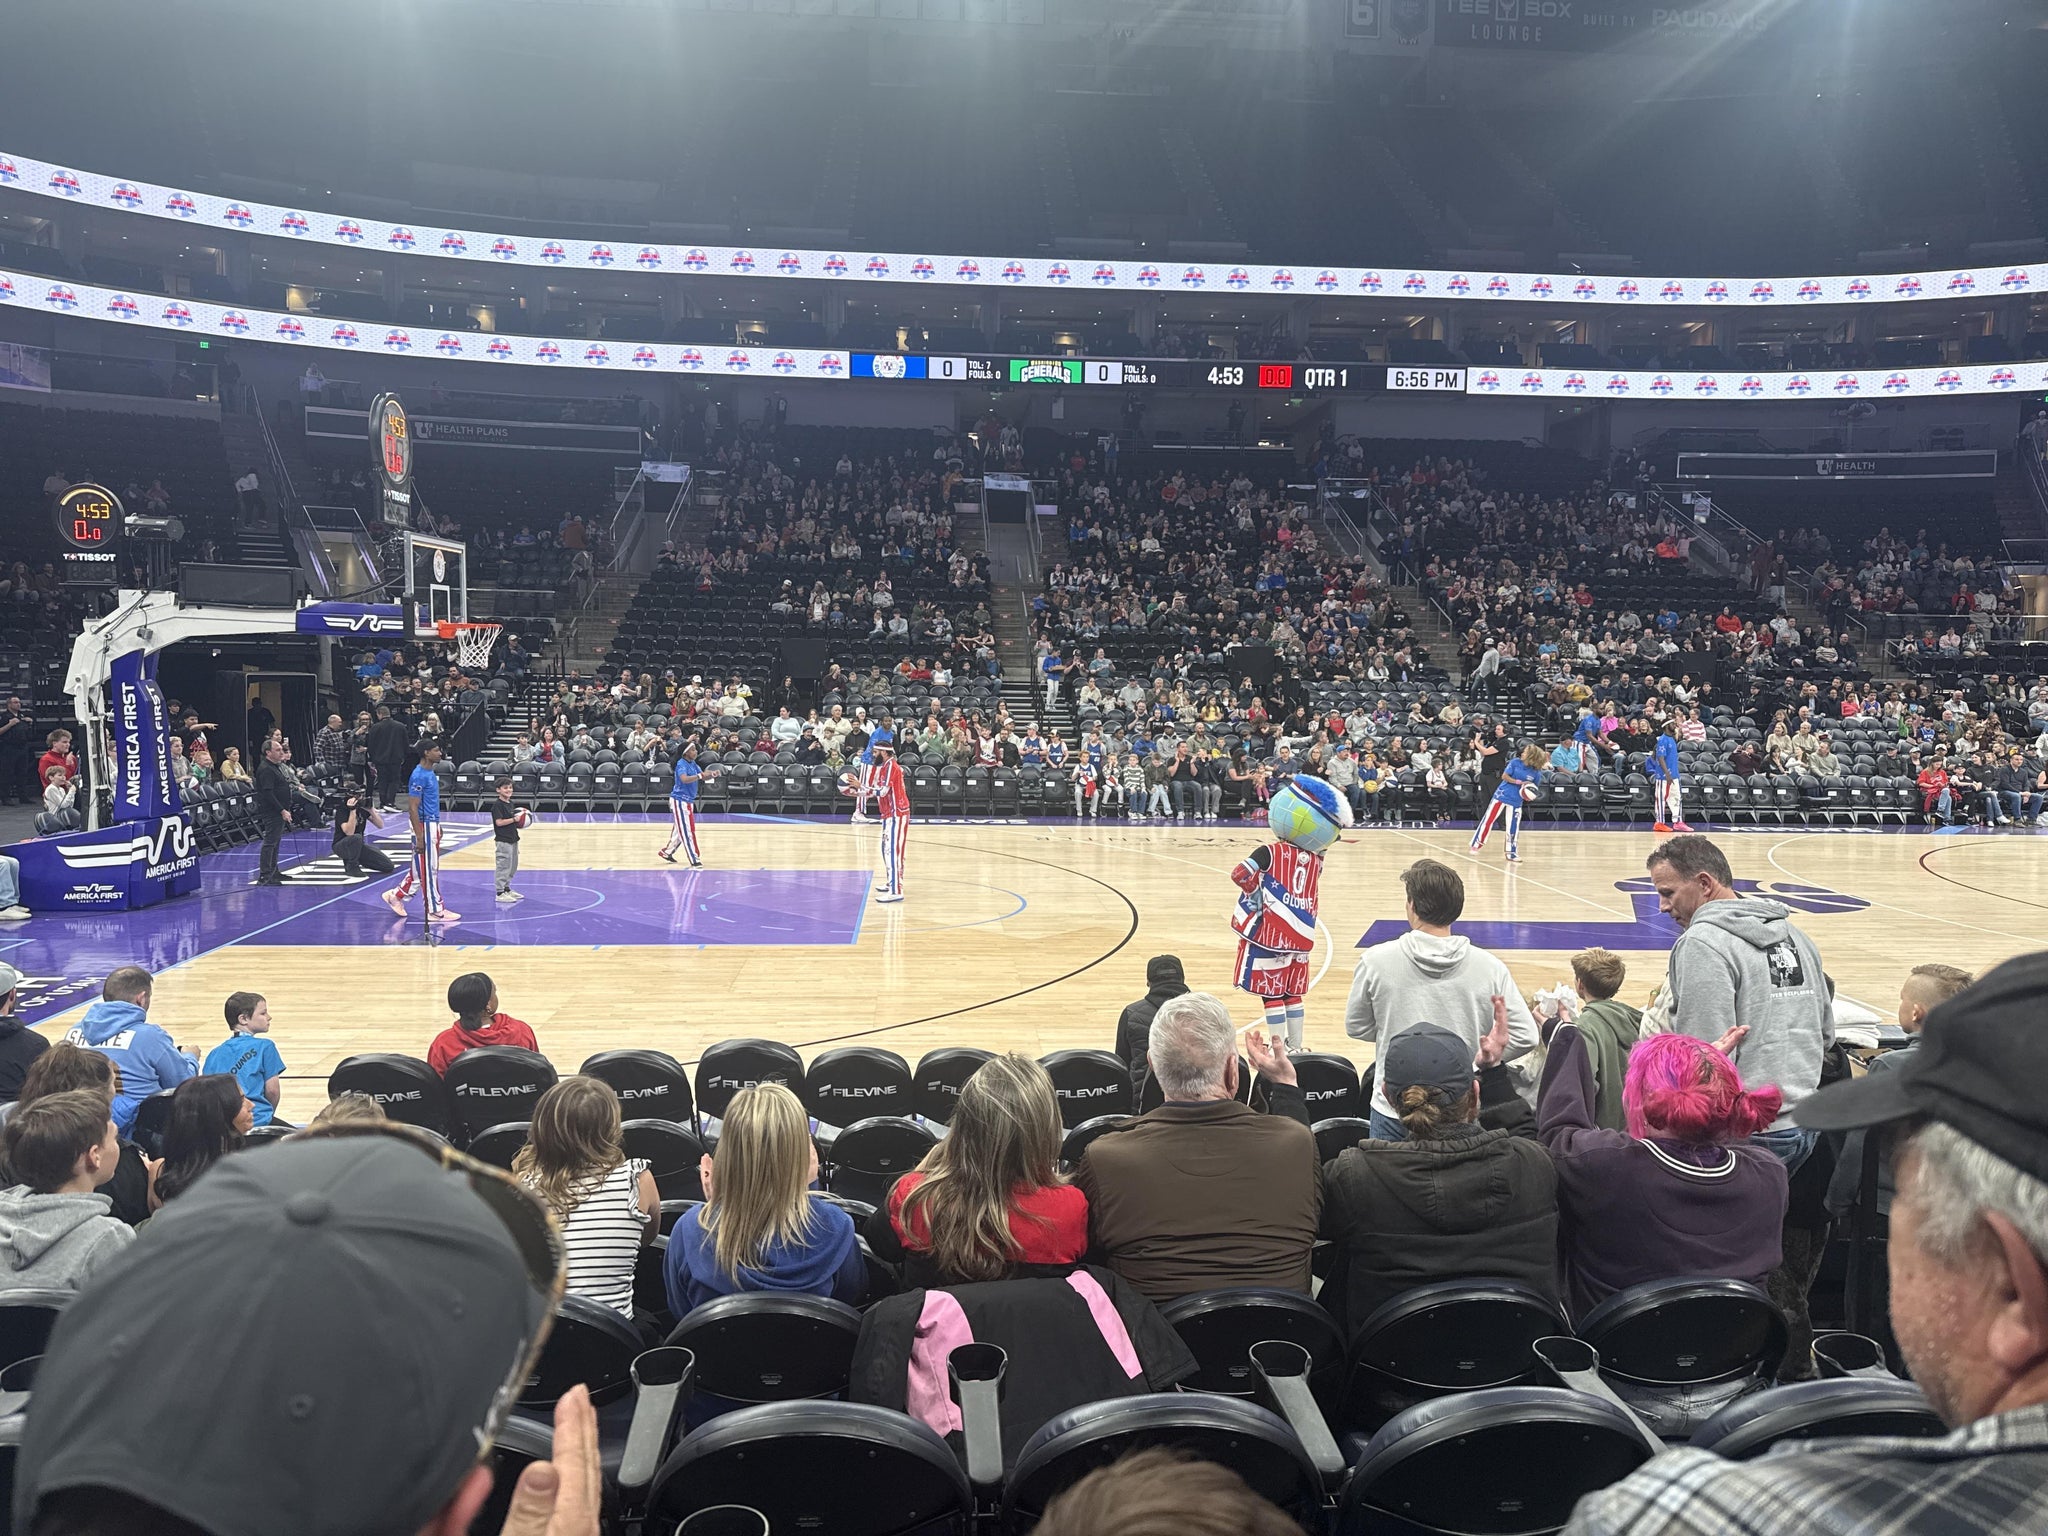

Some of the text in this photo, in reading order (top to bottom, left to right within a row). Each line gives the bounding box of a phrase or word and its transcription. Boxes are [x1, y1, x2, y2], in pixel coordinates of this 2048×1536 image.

[1471, 24, 1543, 43] LOUNGE
[943, 359, 953, 377] 0
[969, 370, 994, 379] FOULS:
[1021, 365, 1071, 383] GENERALS
[1099, 364, 1108, 382] 0
[1124, 374, 1149, 384] FOULS:
[1207, 367, 1244, 386] 4:53
[1304, 369, 1335, 389] QTR
[1340, 369, 1348, 386] 1
[1395, 371, 1429, 388] 6:56
[1435, 371, 1458, 388] PM
[436, 425, 473, 434] HEALTH
[477, 427, 508, 437] PLANS
[1836, 462, 1875, 470] HEALTH
[76, 503, 110, 519] 4:53
[77, 553, 116, 561] TISSOT
[122, 682, 141, 806] AMERICA FIRST
[145, 684, 171, 806] AMERICA FIRST
[145, 856, 196, 879] AMERICA FIRST
[1292, 866, 1307, 894] 0
[1282, 892, 1313, 911] GLOBIE
[230, 1047, 258, 1075] OUNDS
[469, 1084, 538, 1097] FILEVINE
[614, 1085, 670, 1100] LEVINE
[832, 1085, 897, 1098] FILEVINE
[1056, 1083, 1119, 1099] FILEVINE
[1304, 1088, 1348, 1101] EVINE
